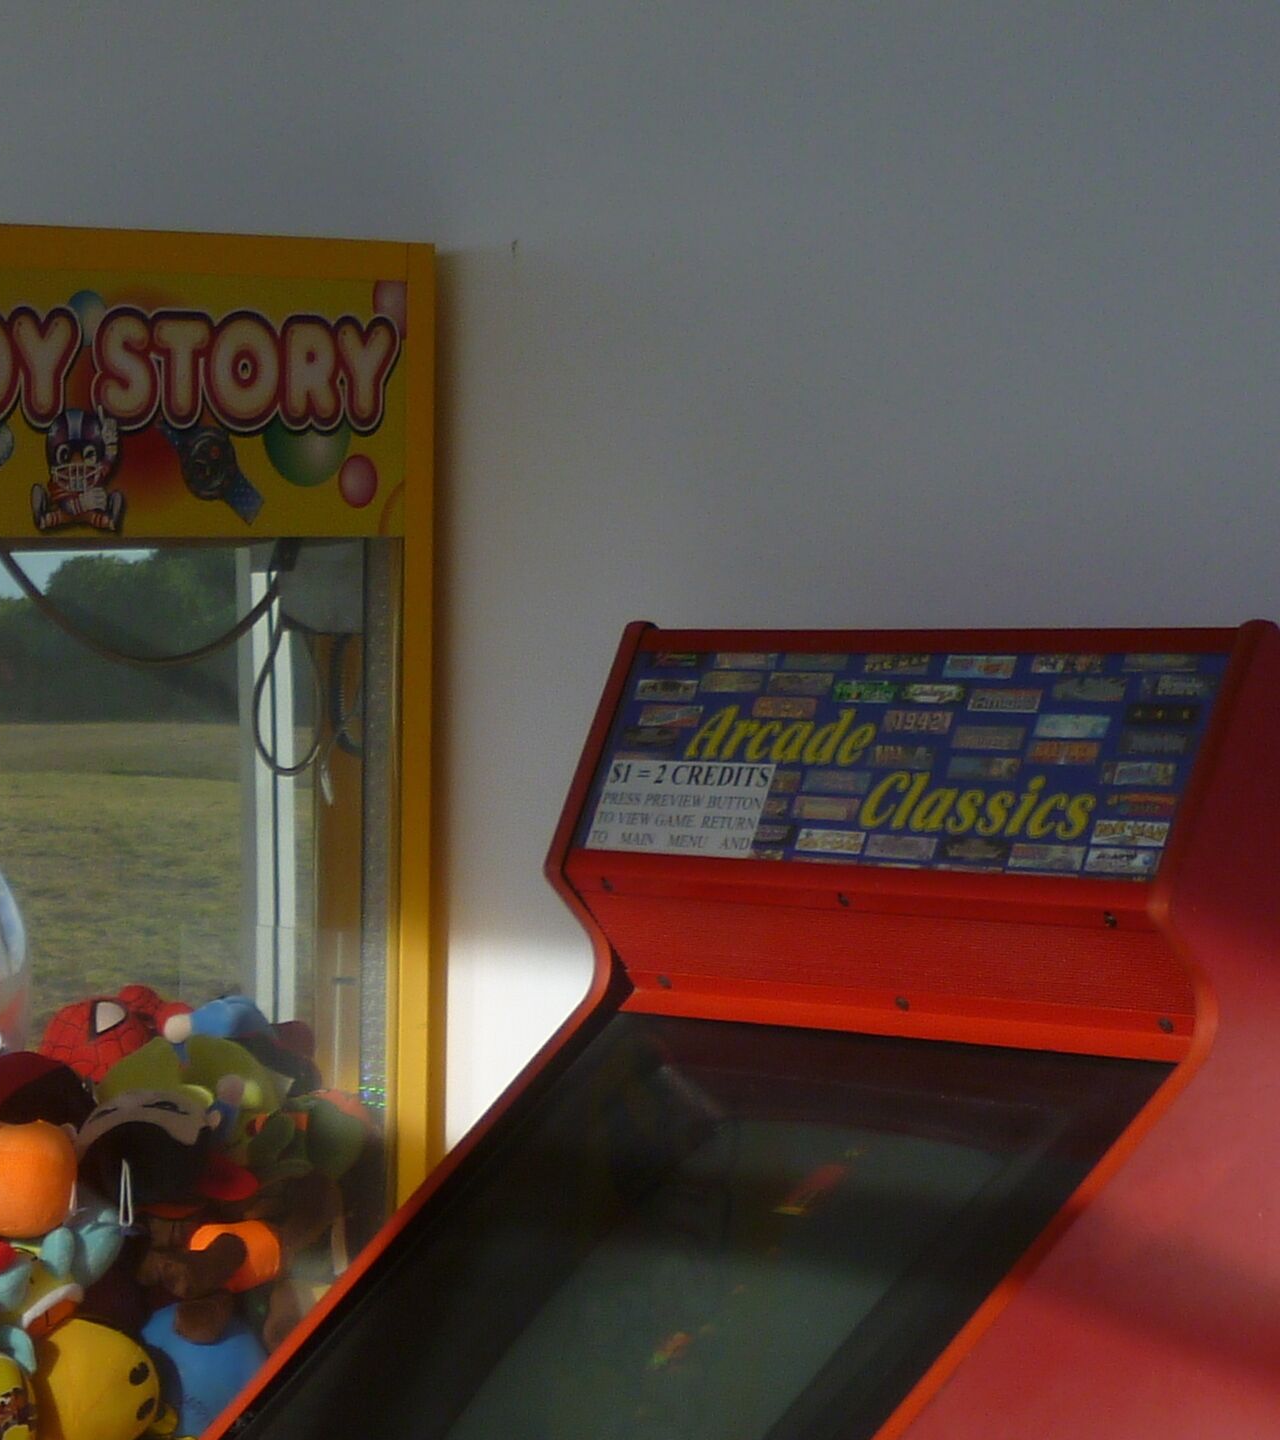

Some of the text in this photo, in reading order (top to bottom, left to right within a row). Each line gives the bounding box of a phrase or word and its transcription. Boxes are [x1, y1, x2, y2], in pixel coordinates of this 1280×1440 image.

[90, 305, 401, 435] STORY
[685, 703, 876, 767] Arcade
[610, 763, 772, 788] $1 = 2 CREDITS
[603, 791, 764, 810] PRESS PREVIEW BUTTON
[858, 770, 1095, 839] Classics
[598, 811, 615, 825] TO
[618, 812, 653, 827] VIEW
[701, 815, 757, 831] RETURN
[593, 830, 752, 851] TO MAIN MENU AND
